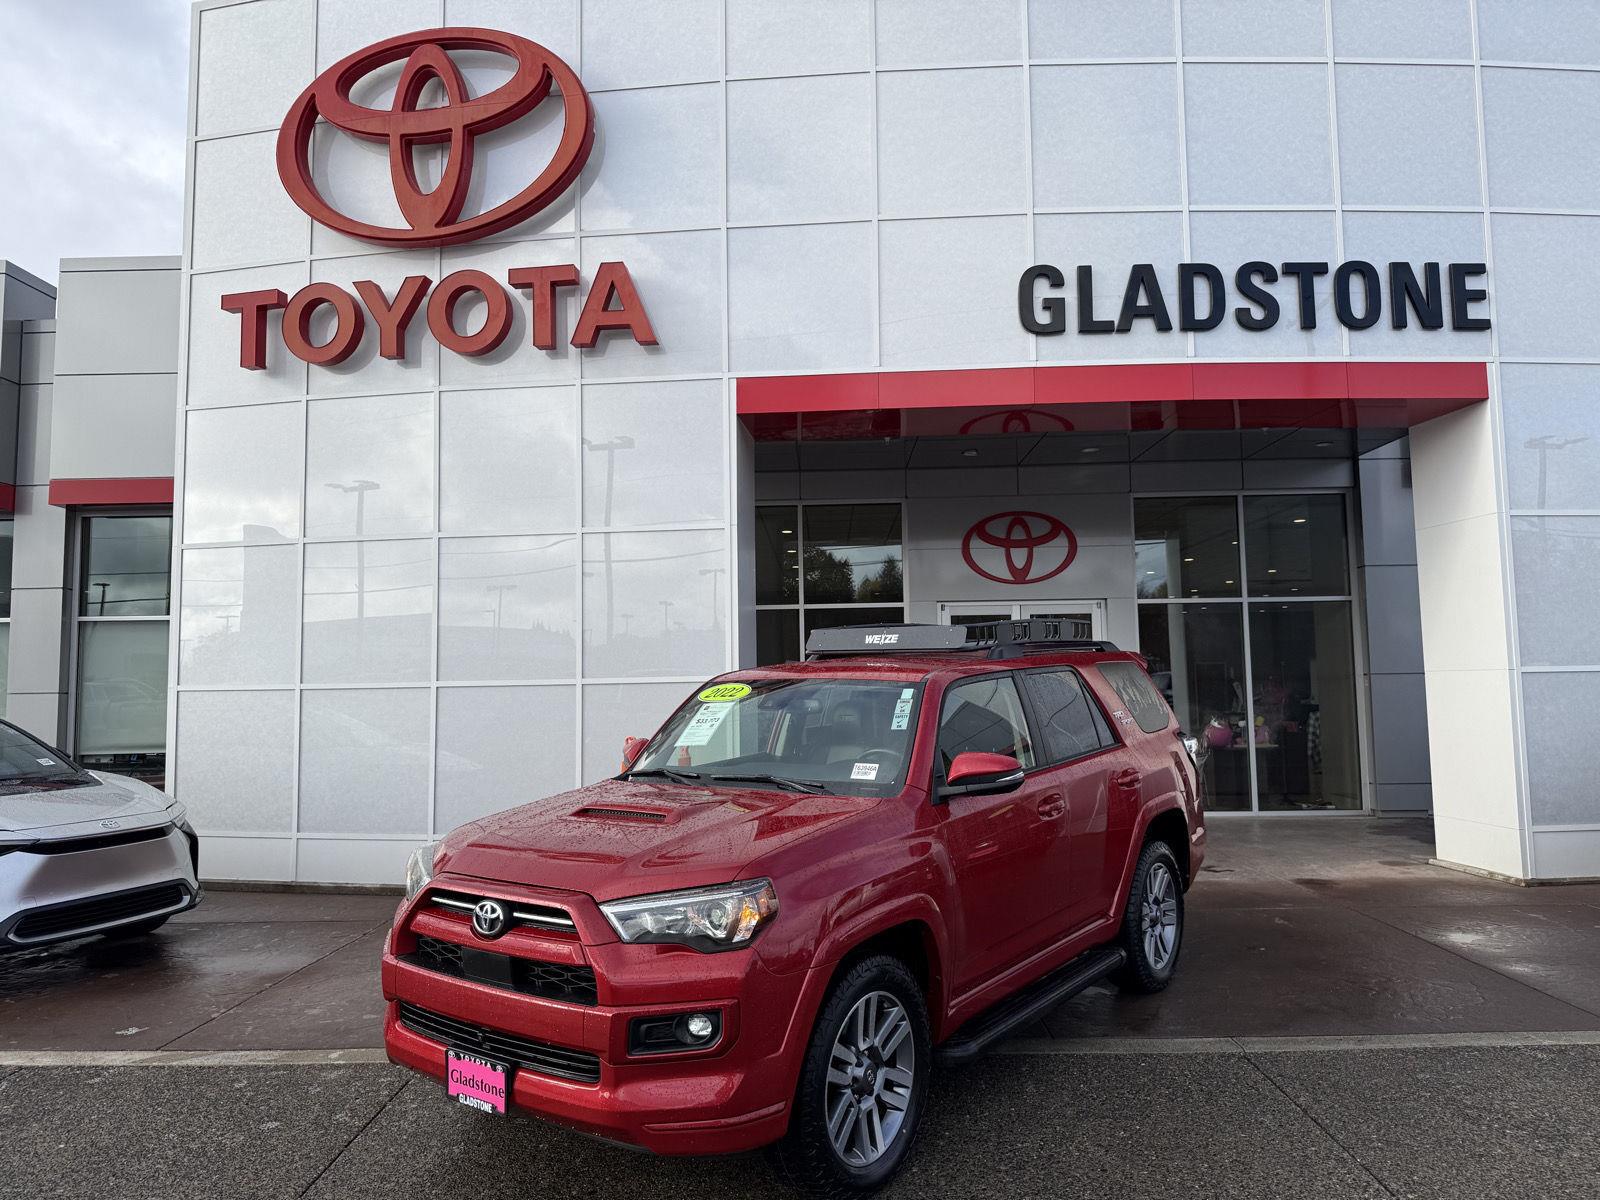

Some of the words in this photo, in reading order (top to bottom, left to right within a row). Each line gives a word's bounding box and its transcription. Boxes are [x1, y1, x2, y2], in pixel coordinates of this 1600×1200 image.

[1018, 260, 1492, 335] GLADSTONE
[220, 261, 660, 371] TOYOTA
[703, 687, 745, 698] 2022
[460, 1053, 491, 1068] TOYOTA
[450, 1069, 505, 1098] Gladstone
[458, 1093, 493, 1114] GLADSTONE
